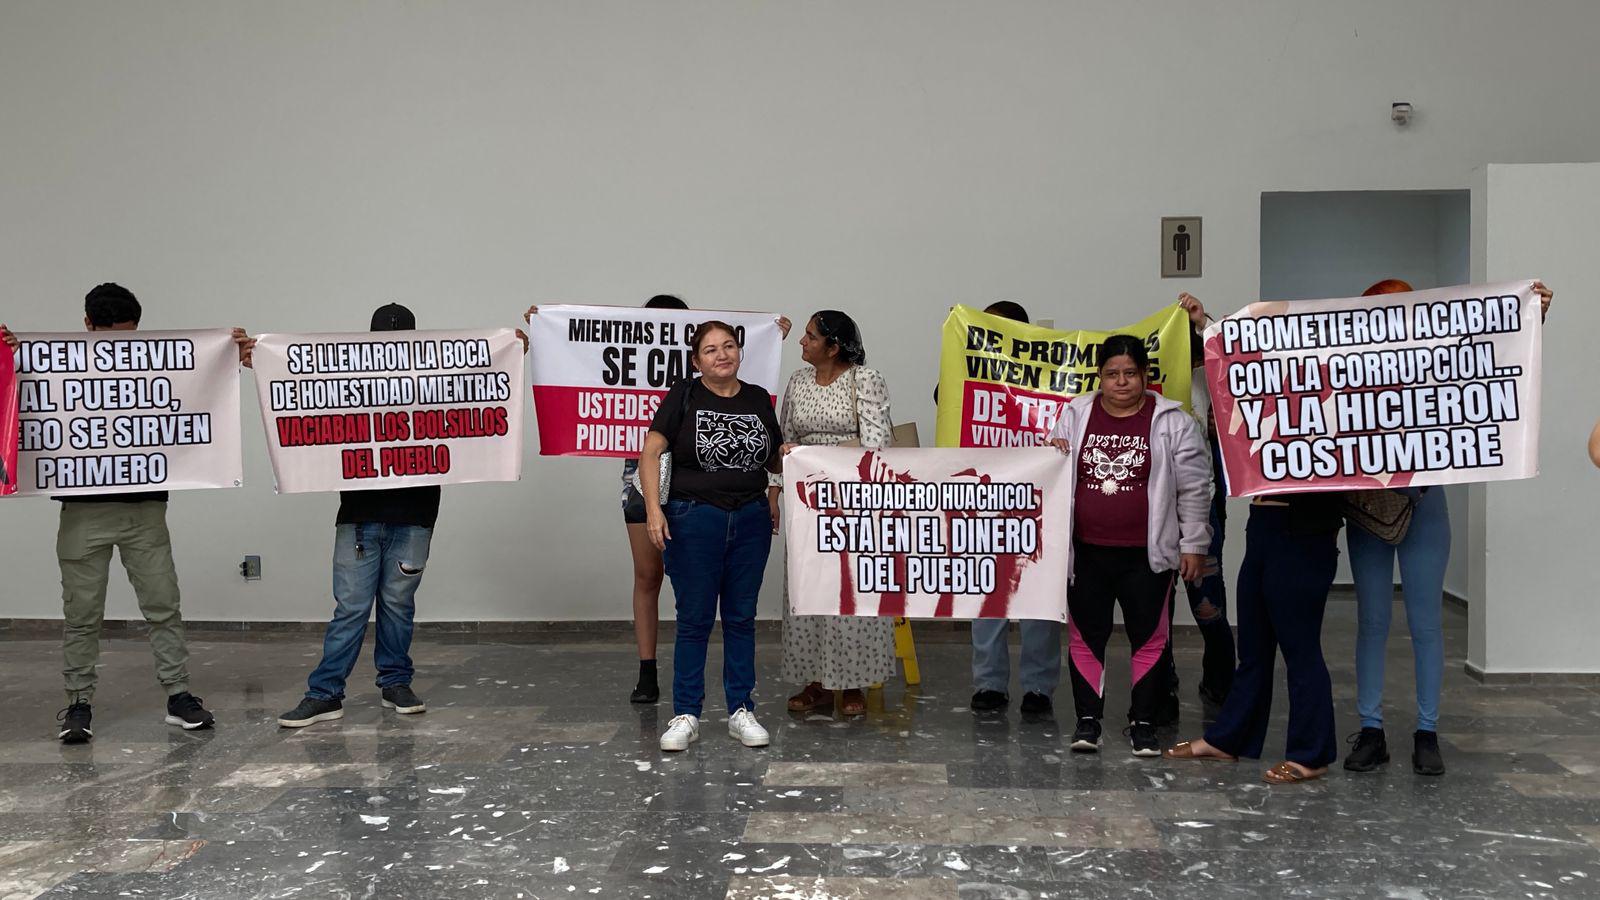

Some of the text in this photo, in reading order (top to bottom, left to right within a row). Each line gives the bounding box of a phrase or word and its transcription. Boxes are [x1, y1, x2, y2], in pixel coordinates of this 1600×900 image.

[568, 318, 654, 345] MIENTRAS
[660, 322, 678, 346] EL
[967, 325, 1004, 353] DE
[1222, 295, 1521, 354] PROMETIERON ACABAR
[94, 339, 195, 371] SERVIR
[287, 339, 491, 374] SE LLENARON LA BOCA
[602, 347, 637, 387] SE
[966, 355, 1042, 389] VIVEN
[1228, 335, 1522, 397] CON LA CORRUPCIÓN...
[19, 376, 181, 412] AL PUEBLO,
[271, 372, 510, 411] DE HONESTIDAD MIENTRAS
[578, 392, 661, 421] USTEDES
[972, 389, 1007, 424] DE
[1239, 379, 1519, 439] Y LA HICIERON
[70, 417, 107, 449] SE
[113, 413, 211, 447] SIRVEN
[276, 407, 508, 447] VACIABAN LOS BOLSILLOS
[36, 453, 168, 489] PRIMERO
[341, 444, 450, 479] DEL PUEBLO
[1261, 425, 1503, 482] COSTUMBRE
[816, 482, 1037, 511] EL VERDADERO HUACHICOL
[817, 509, 1038, 555] ESTÁ EN EL DINERO
[858, 556, 996, 595] DEL PUEBLO
